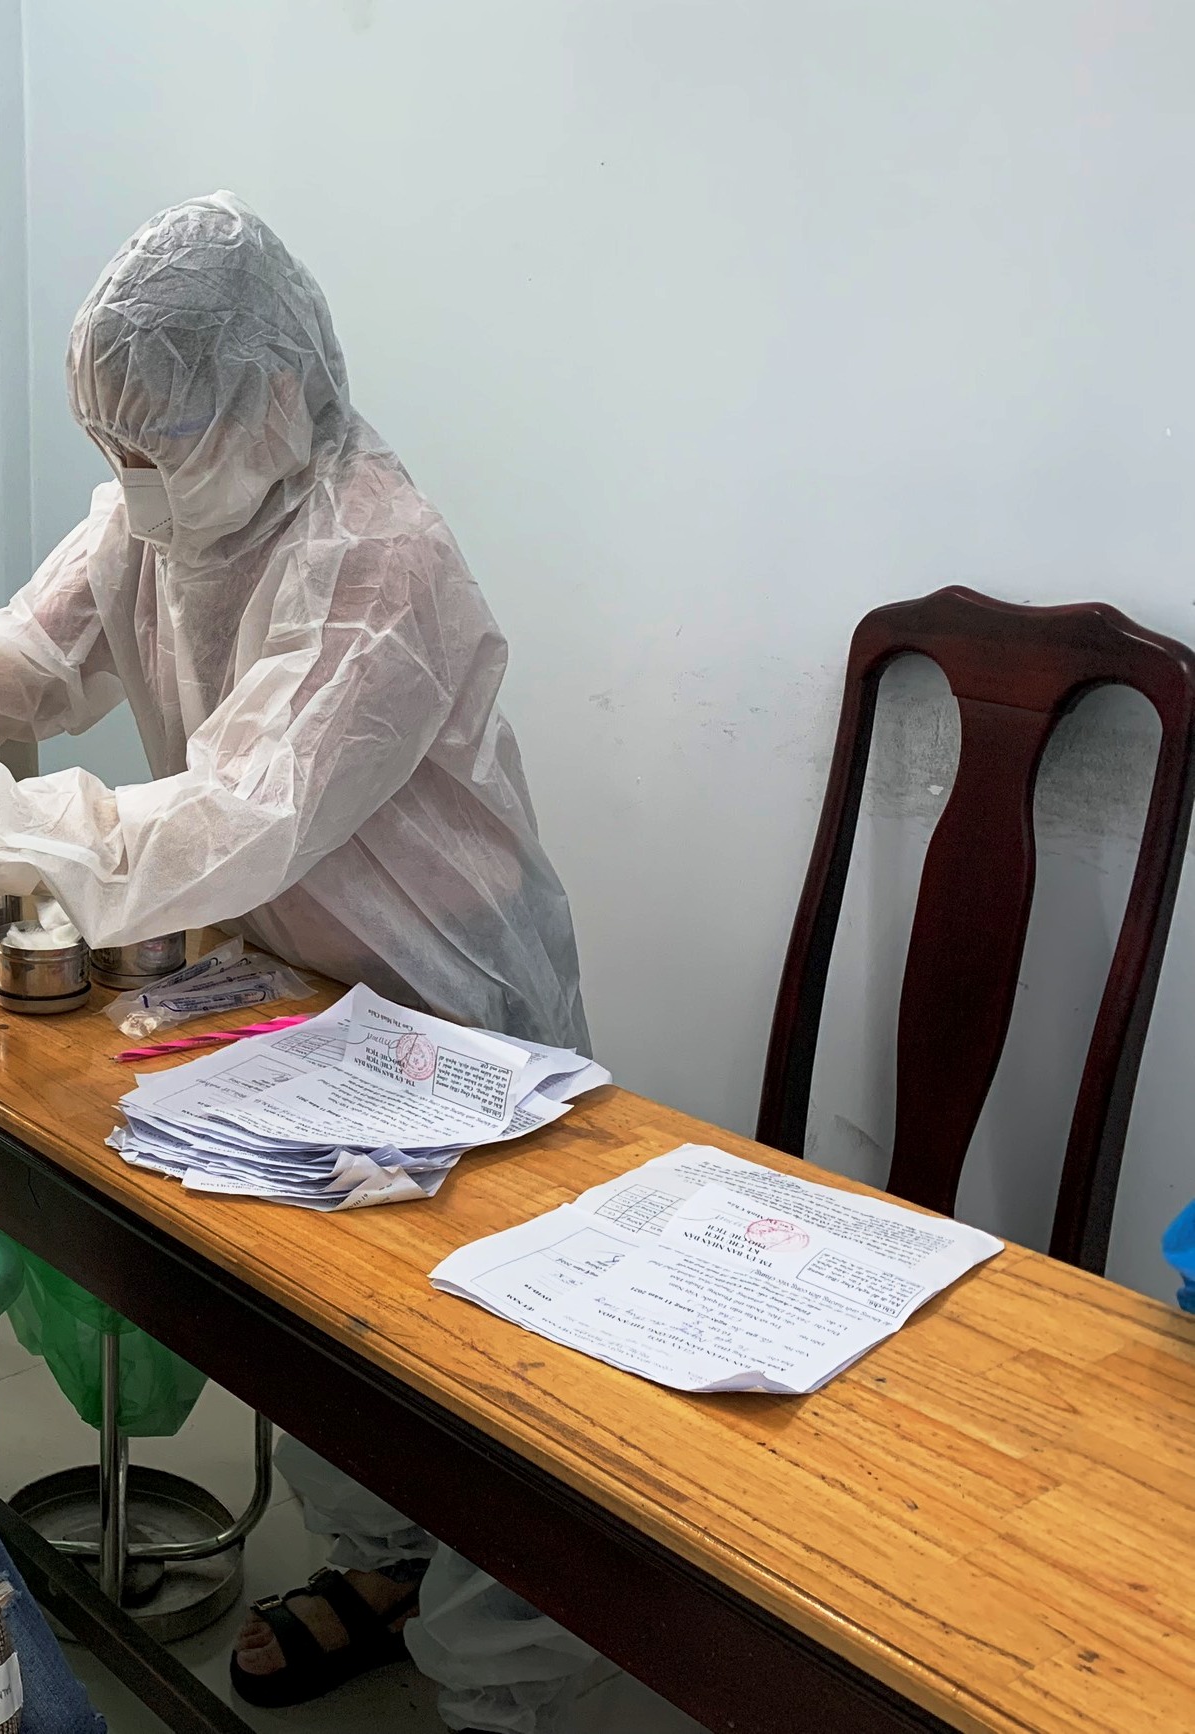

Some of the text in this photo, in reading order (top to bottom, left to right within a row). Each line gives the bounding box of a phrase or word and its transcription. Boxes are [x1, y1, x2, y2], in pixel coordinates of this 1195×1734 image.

[366, 1047, 379, 1057] TỊCH
[354, 1058, 366, 1068] DÂN
[366, 1055, 379, 1065] TỊCH
[366, 1063, 382, 1075] NHÂN
[382, 1070, 394, 1079] BAN
[707, 1225, 728, 1235] TỊCH
[682, 1231, 702, 1243] DÂN
[704, 1232, 726, 1242] TỊCH
[700, 1239, 725, 1251] NHÂN
[725, 1248, 744, 1257] BAN
